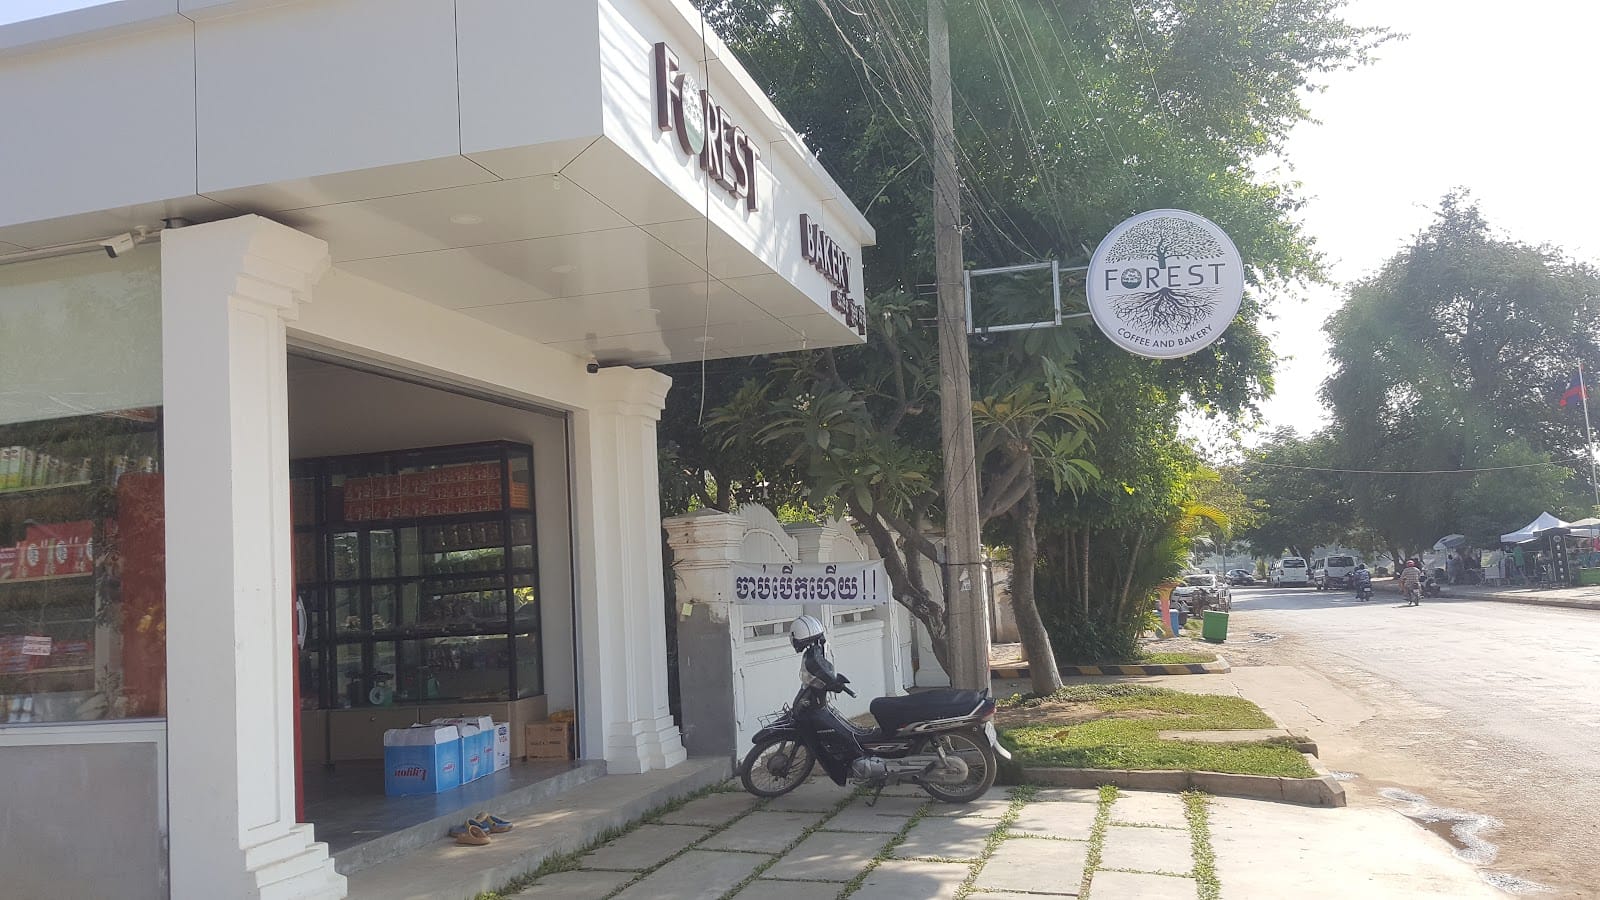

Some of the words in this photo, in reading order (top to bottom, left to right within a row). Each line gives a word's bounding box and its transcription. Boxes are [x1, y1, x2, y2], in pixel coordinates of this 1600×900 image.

[655, 41, 760, 213] FOREST
[799, 213, 852, 293] BAKERY
[1105, 263, 1226, 291] FOREST
[1117, 327, 1150, 347] COFFEE
[1152, 340, 1175, 348] AND
[1178, 324, 1213, 346] BAKERY
